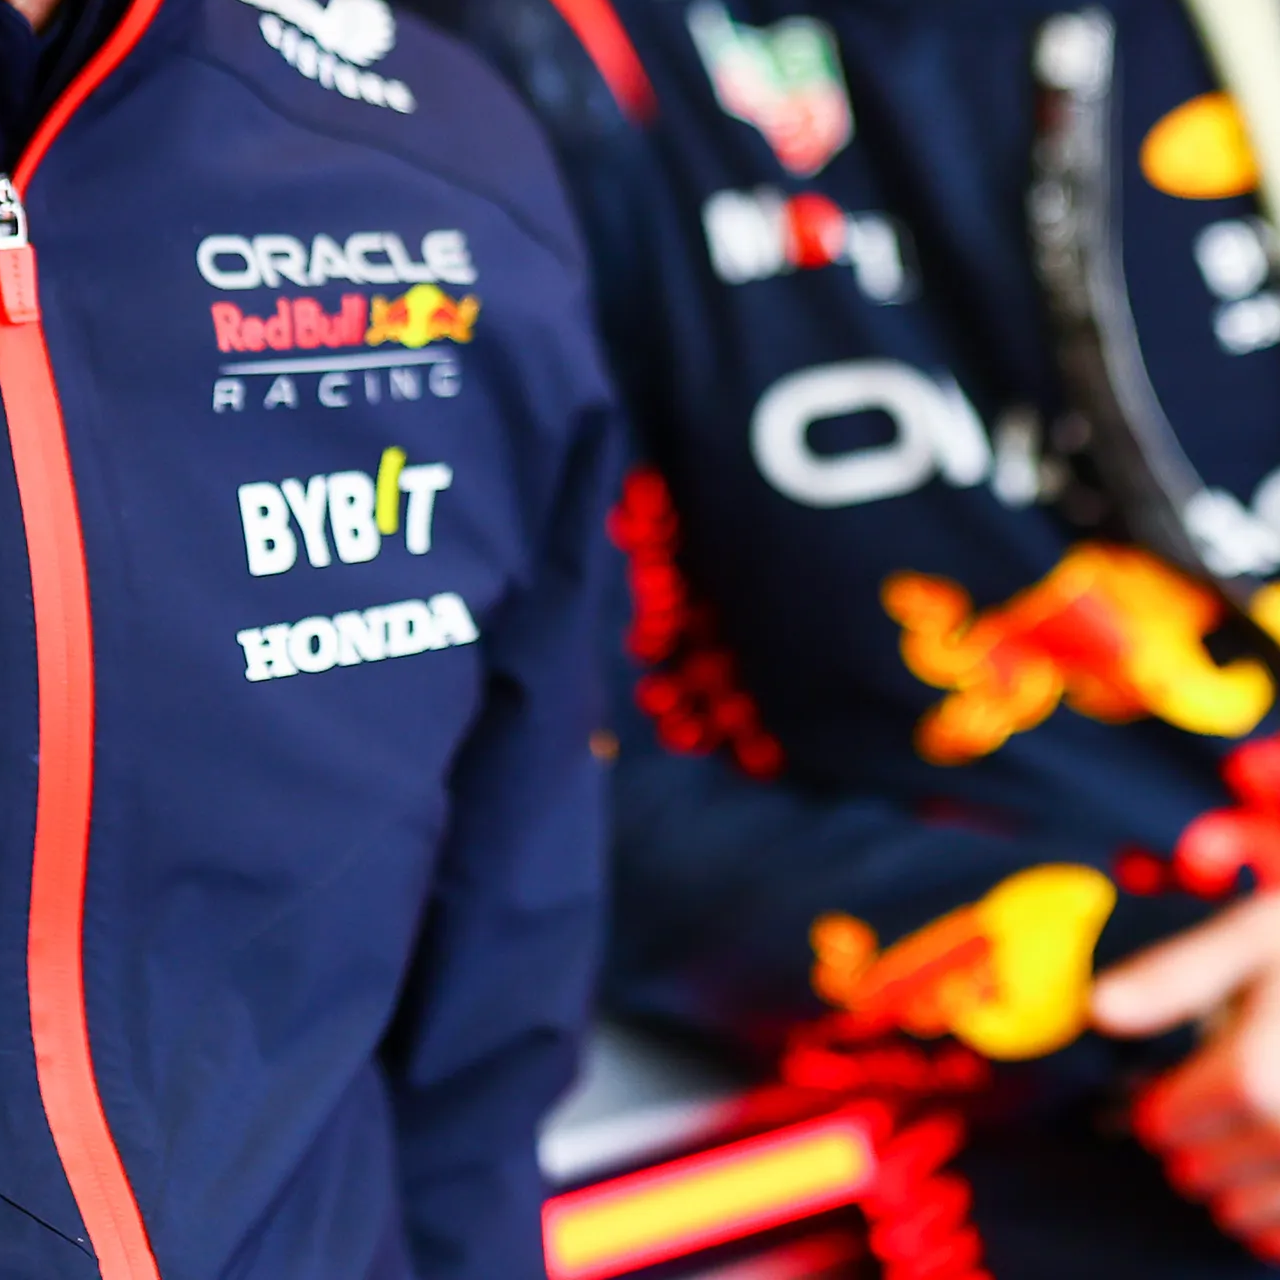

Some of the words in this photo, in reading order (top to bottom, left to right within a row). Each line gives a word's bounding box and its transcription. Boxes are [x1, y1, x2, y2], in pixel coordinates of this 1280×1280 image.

[196, 229, 479, 290] ORACLE
[212, 361, 463, 414] RACING
[238, 446, 453, 577] BYBIT
[237, 592, 481, 683] HONDA
